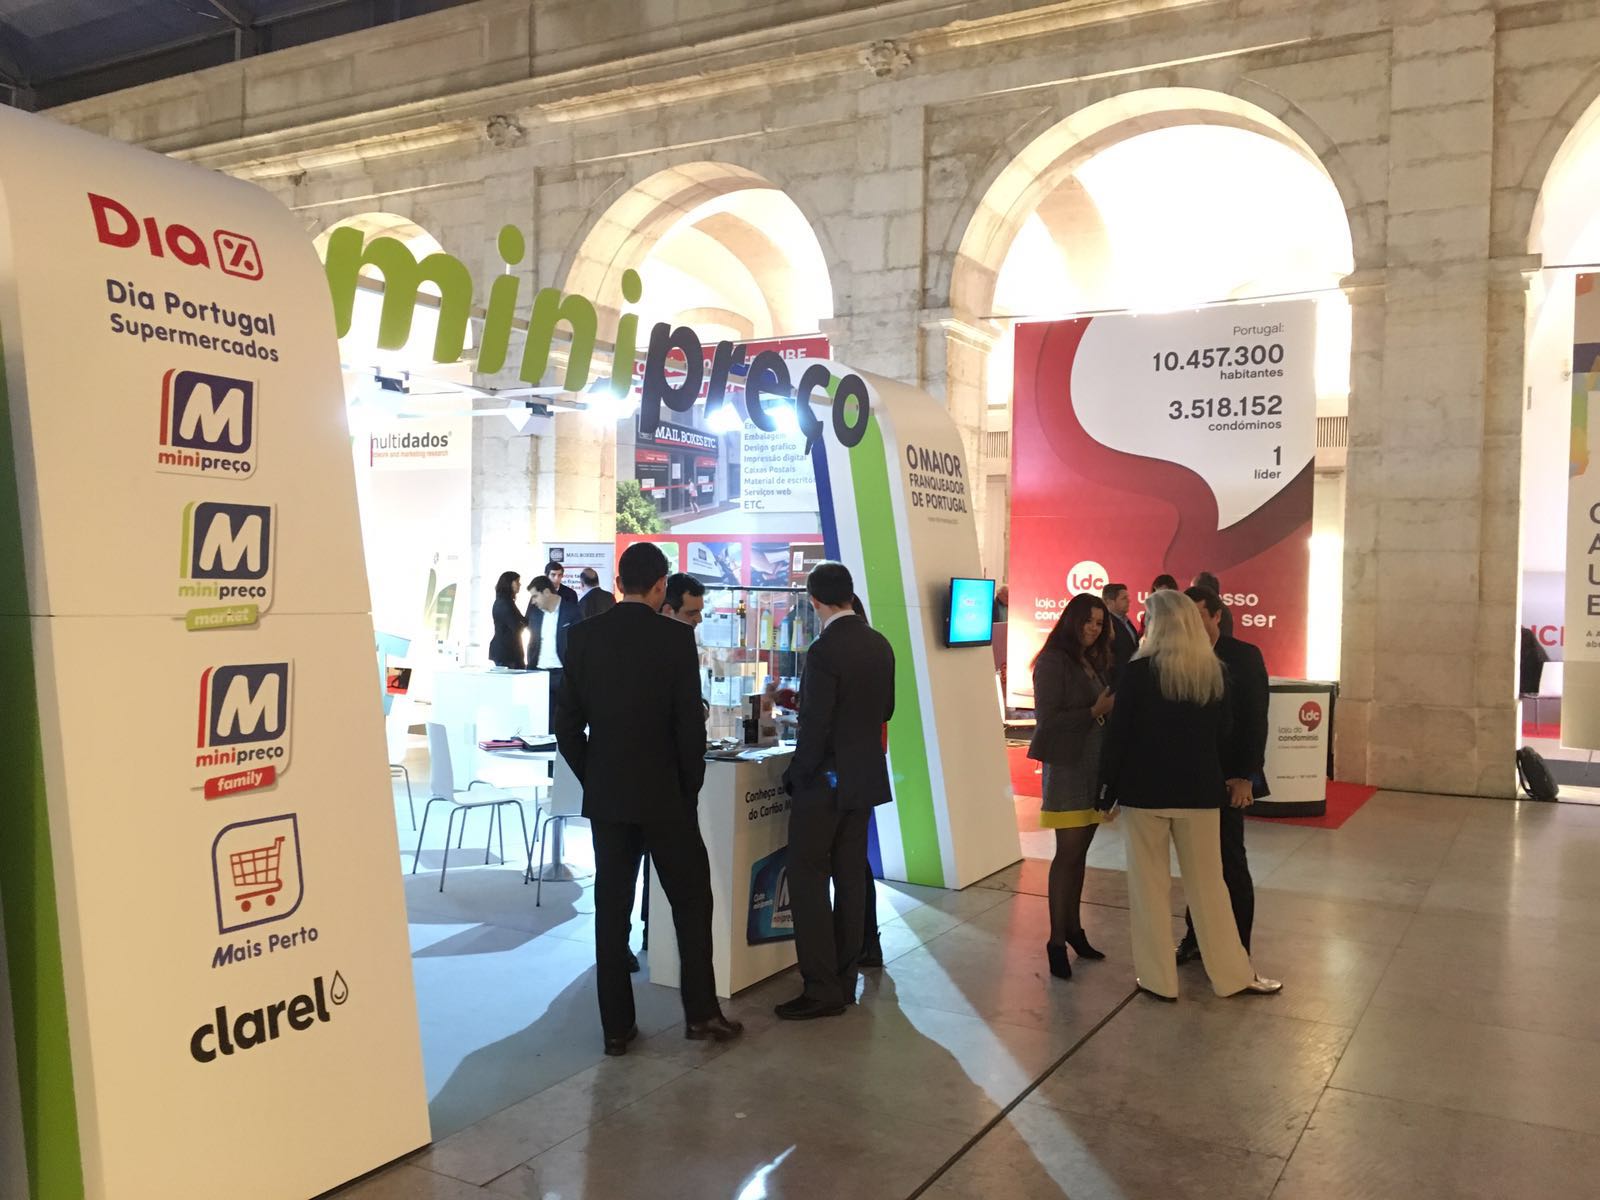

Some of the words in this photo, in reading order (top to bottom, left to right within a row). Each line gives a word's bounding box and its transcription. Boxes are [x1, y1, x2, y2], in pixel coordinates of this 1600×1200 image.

[106, 279, 155, 311] Dia
[165, 292, 276, 336] Portugal
[110, 313, 279, 362] Supermercados
[325, 223, 870, 448] minipreço
[1233, 323, 1285, 336] Portugal:
[1153, 343, 1284, 371] 10.457.300
[1220, 367, 1284, 380] habitantes
[1168, 395, 1283, 420] 3.518.152
[1208, 419, 1282, 432] condóminos
[655, 426, 680, 441] MAIL
[681, 431, 704, 446] BOXES
[744, 444, 769, 452] Design
[1273, 445, 1282, 466] 1
[158, 451, 251, 474] minipreço
[782, 454, 807, 462] digital
[906, 444, 918, 470] O
[919, 447, 962, 478] MAIOR
[769, 465, 796, 473] Postais
[1254, 468, 1281, 480] líder
[744, 477, 775, 485] Material
[776, 476, 786, 484] de
[909, 473, 965, 494] FRANQUEADOR
[744, 488, 775, 497] Serviços
[744, 500, 765, 509] ETC.
[912, 491, 924, 508] DE
[926, 493, 967, 514] PORTUGAL
[1073, 573, 1104, 590] ldc
[178, 582, 266, 600] minipreço
[1035, 597, 1056, 609] loja
[194, 608, 249, 626] market
[1241, 614, 1276, 628] ser
[1301, 709, 1319, 721] ldc
[195, 746, 284, 767] minipreço
[217, 770, 263, 792] family
[745, 788, 776, 803] Conheça
[748, 808, 758, 820] do
[760, 802, 783, 817] Cartão
[211, 940, 262, 969] Mais
[269, 926, 319, 952] Perto
[190, 976, 331, 1063] clarel
